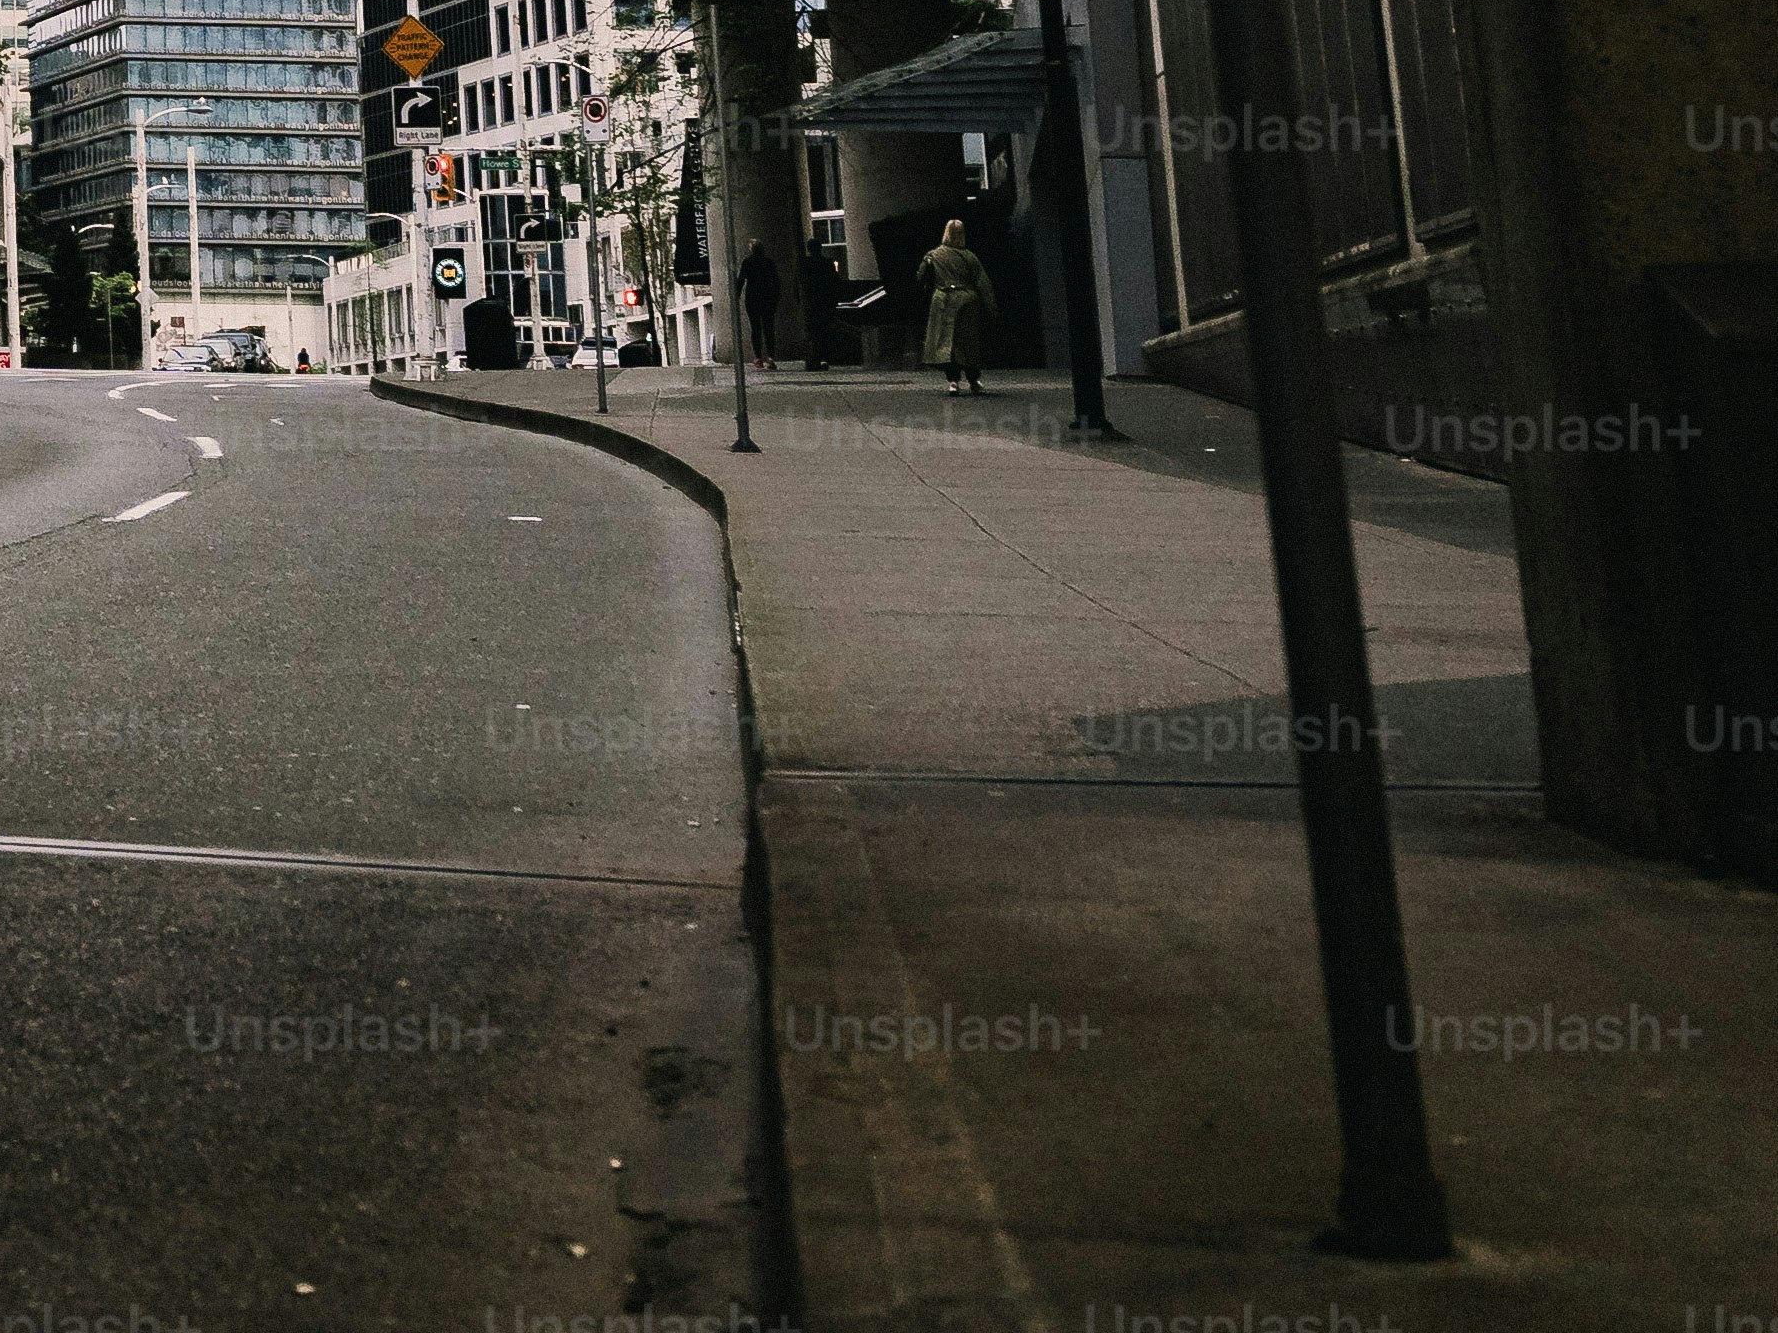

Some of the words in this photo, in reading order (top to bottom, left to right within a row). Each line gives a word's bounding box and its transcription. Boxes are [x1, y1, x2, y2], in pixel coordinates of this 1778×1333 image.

[397, 33, 428, 41] TRAFFIC
[397, 42, 429, 51] PATTERN
[399, 131, 420, 141] Right
[421, 130, 439, 140] Lane
[482, 158, 510, 169] Howe
[512, 158, 520, 168] S
